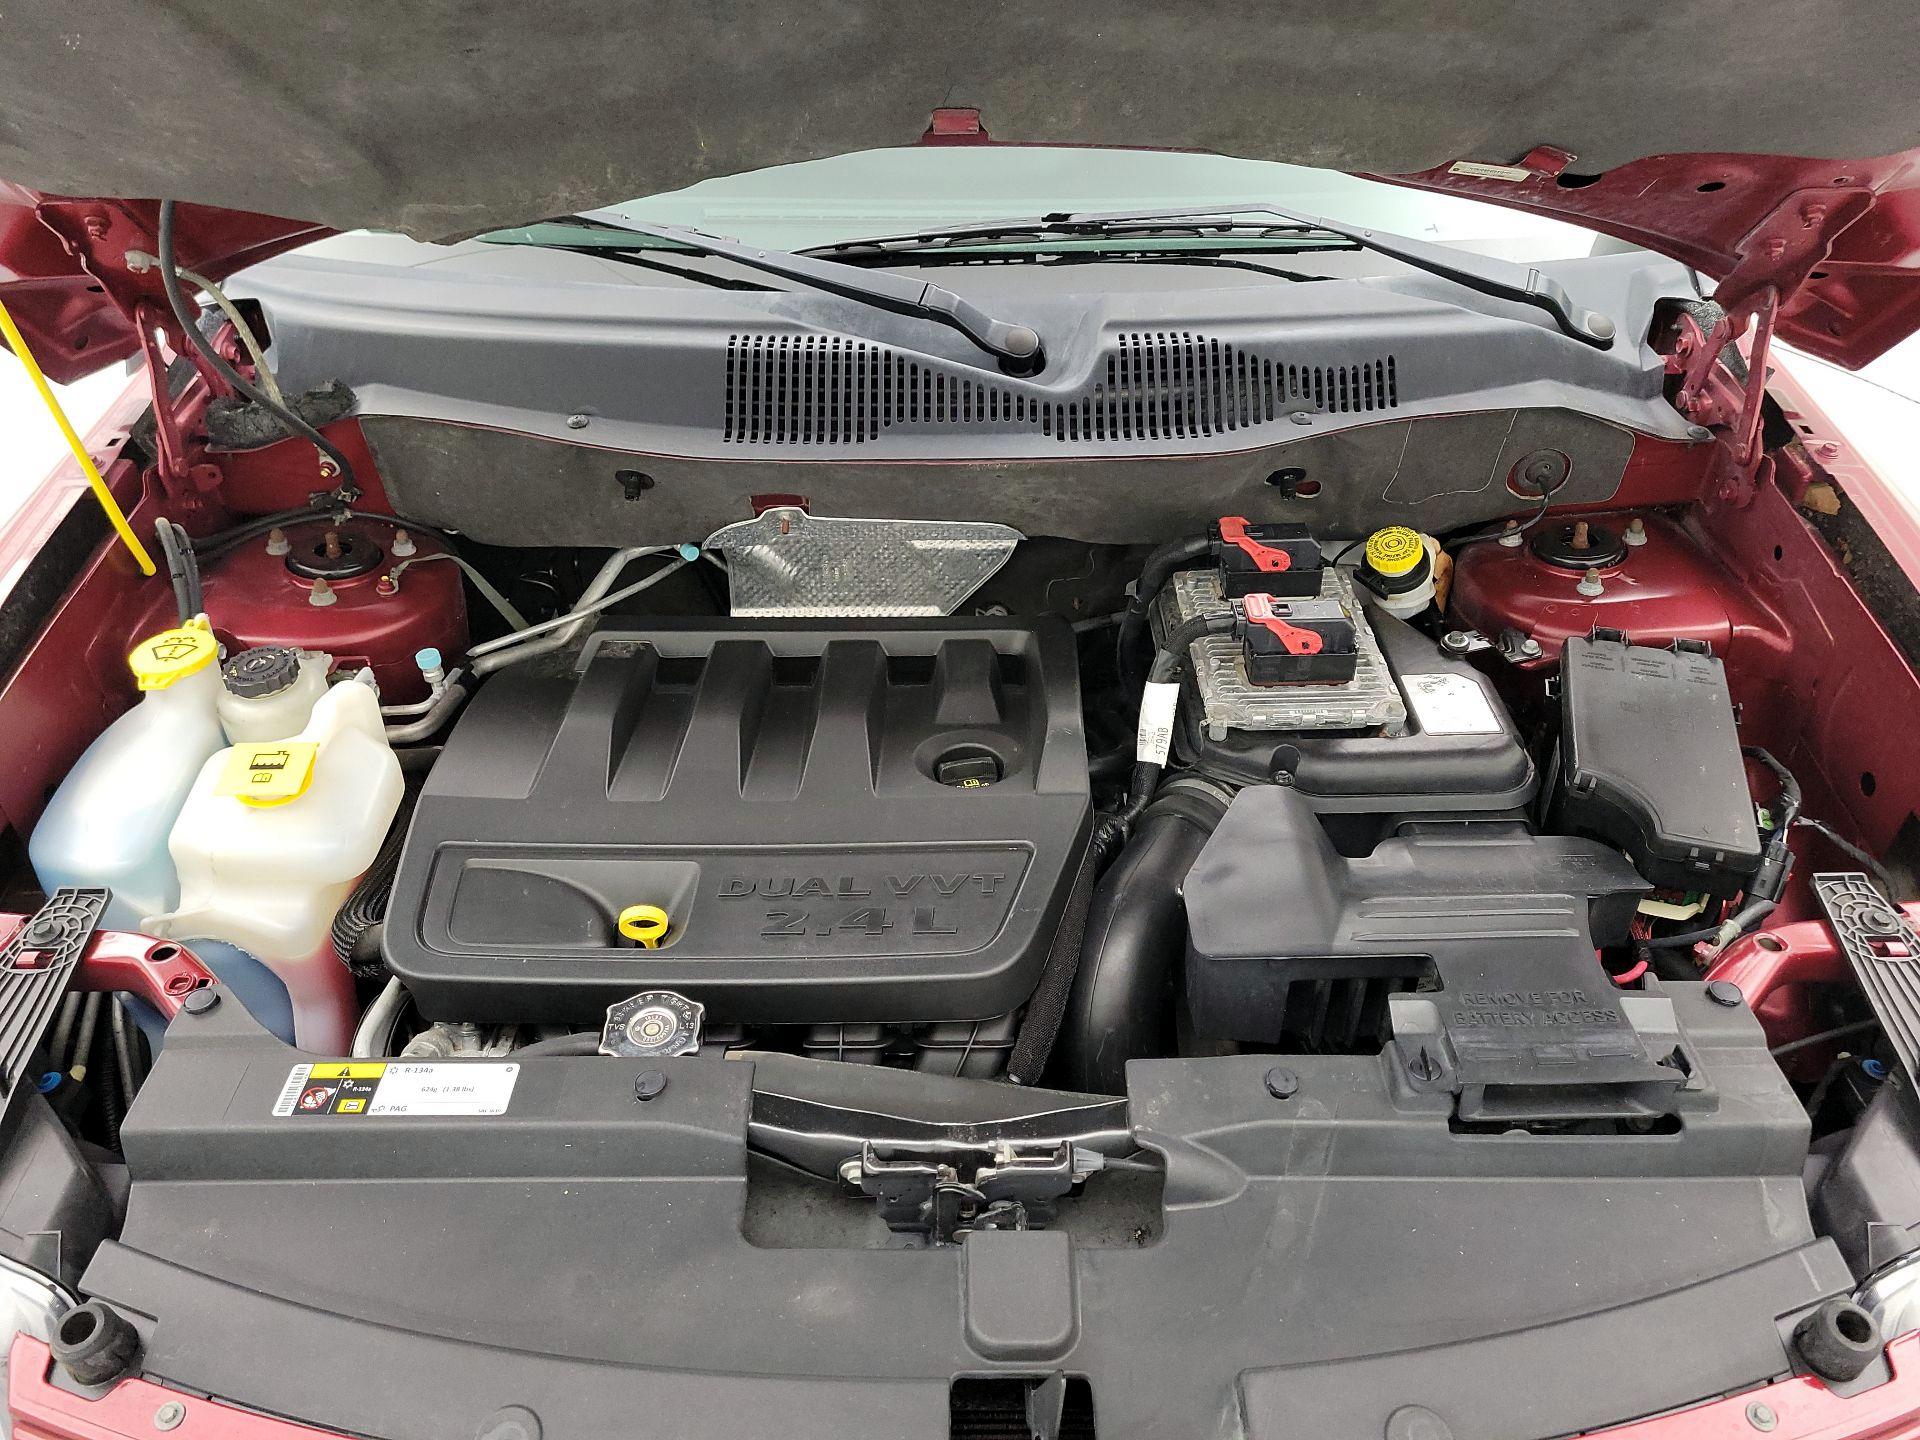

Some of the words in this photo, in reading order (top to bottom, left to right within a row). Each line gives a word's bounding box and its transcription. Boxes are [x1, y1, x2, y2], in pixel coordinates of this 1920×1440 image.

[717, 874, 872, 898] DUAL
[884, 872, 1006, 896] VVT
[1460, 992, 1544, 1006] REMOVE
[1546, 989, 1588, 1004] FOR
[1453, 1011, 1535, 1026] BATTERY
[1543, 1010, 1618, 1025] ACCESS
[607, 1023, 626, 1031] TVS
[404, 1066, 434, 1074] R-134a
